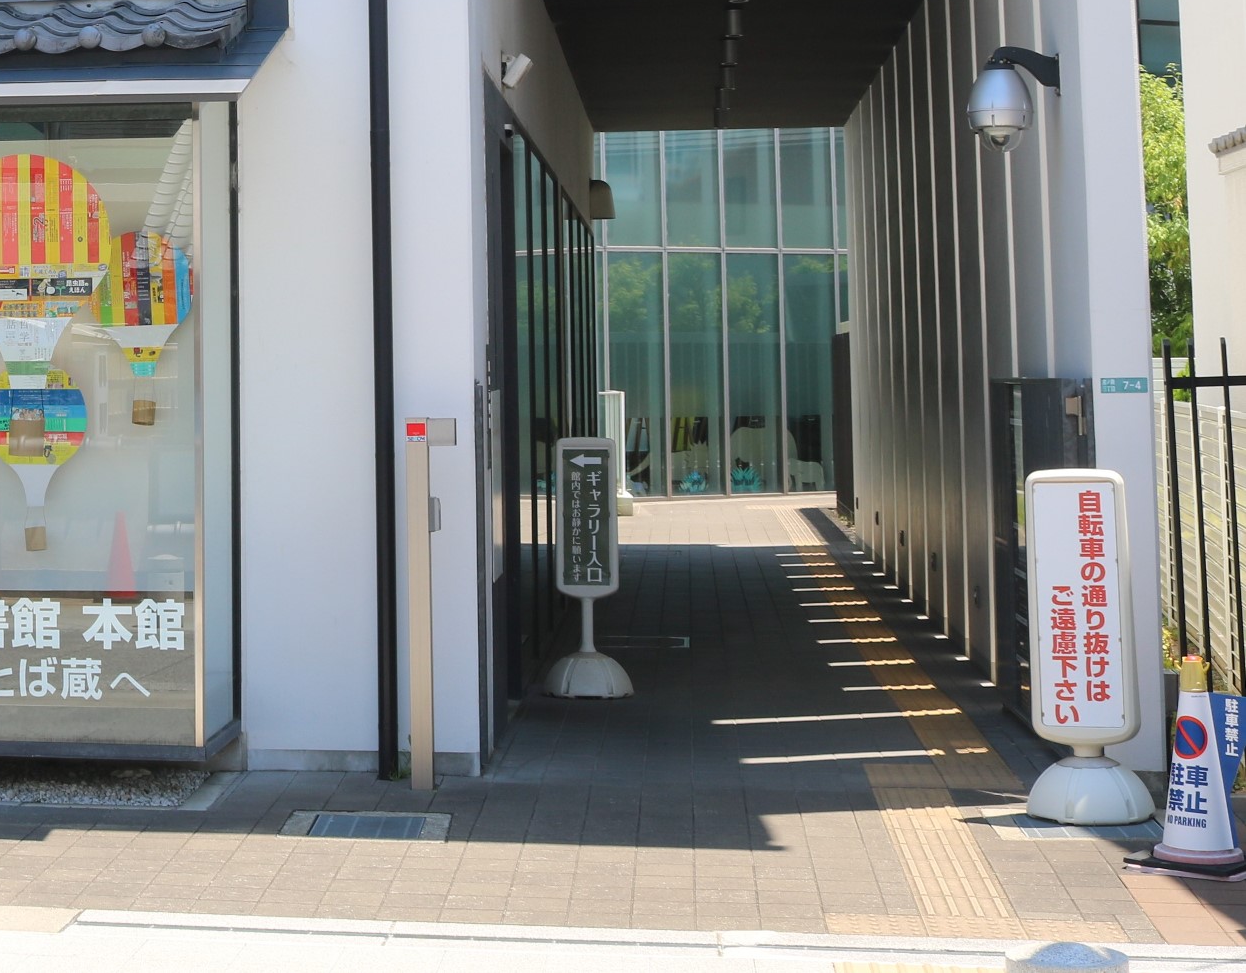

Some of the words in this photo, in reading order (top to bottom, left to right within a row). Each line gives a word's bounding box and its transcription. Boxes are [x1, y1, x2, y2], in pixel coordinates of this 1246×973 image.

[1123, 380, 1141, 390] 7-4
[570, 470, 582, 583] 館内ではお静かに願います
[586, 470, 603, 583] ギャラリー入口
[1078, 490, 1112, 702] 自転車の通り抜けは
[82, 598, 186, 651] 本館
[1050, 585, 1080, 724] ご遠慮下さい
[1224, 698, 1240, 757] 駐車禁止
[1168, 788, 1208, 815] 禁止
[1171, 763, 1209, 789] 駐車
[1174, 815, 1207, 829] PARKING
